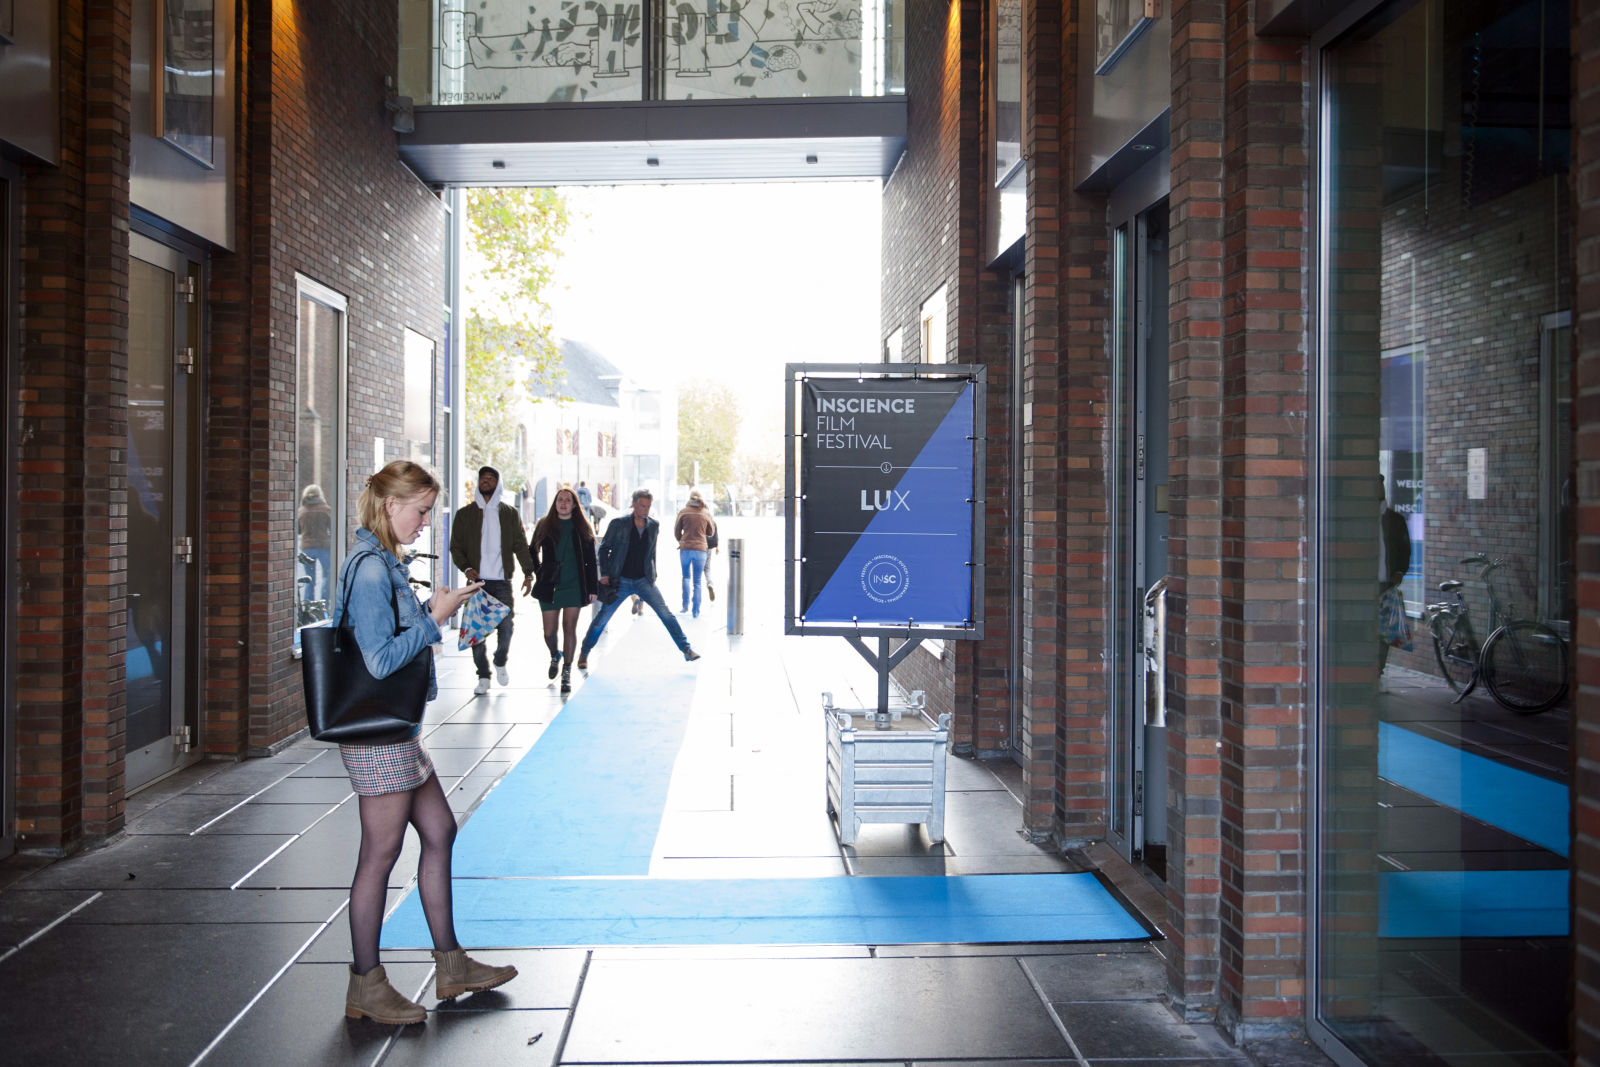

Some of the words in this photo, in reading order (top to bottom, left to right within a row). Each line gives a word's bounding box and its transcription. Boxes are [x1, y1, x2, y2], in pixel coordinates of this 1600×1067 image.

[816, 398, 915, 414] INSCIENCE
[817, 416, 855, 431] FILM
[817, 434, 892, 449] FESTIVAL
[861, 490, 911, 511] LUX
[873, 574, 896, 585] INSC
